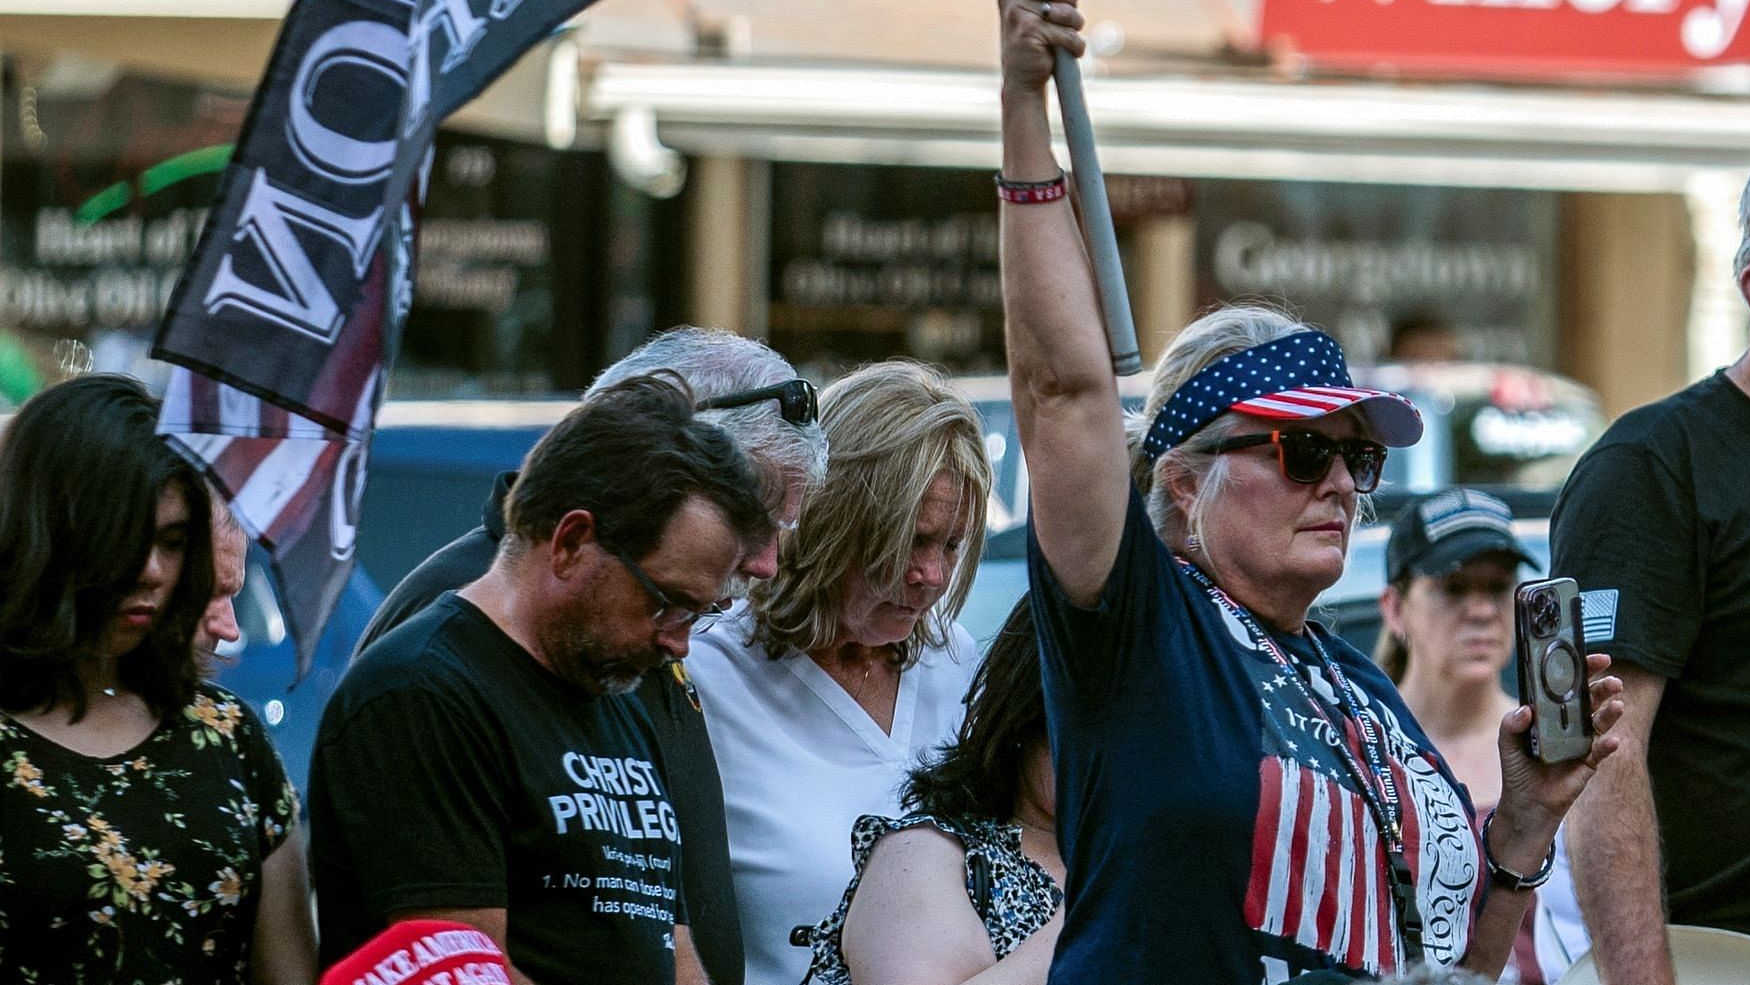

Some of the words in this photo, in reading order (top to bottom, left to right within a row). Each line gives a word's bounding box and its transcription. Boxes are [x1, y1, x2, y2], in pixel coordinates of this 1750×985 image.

[1359, 710, 1378, 744] Trump
[1367, 744, 1380, 764] 2024
[563, 751, 661, 796] CHRIST
[1381, 764, 1399, 805] Trump
[548, 792, 681, 845] PRIVILEG
[564, 873, 591, 888] No
[596, 877, 623, 889] man
[625, 879, 639, 892] can
[592, 896, 620, 913] has
[623, 902, 656, 919] opened
